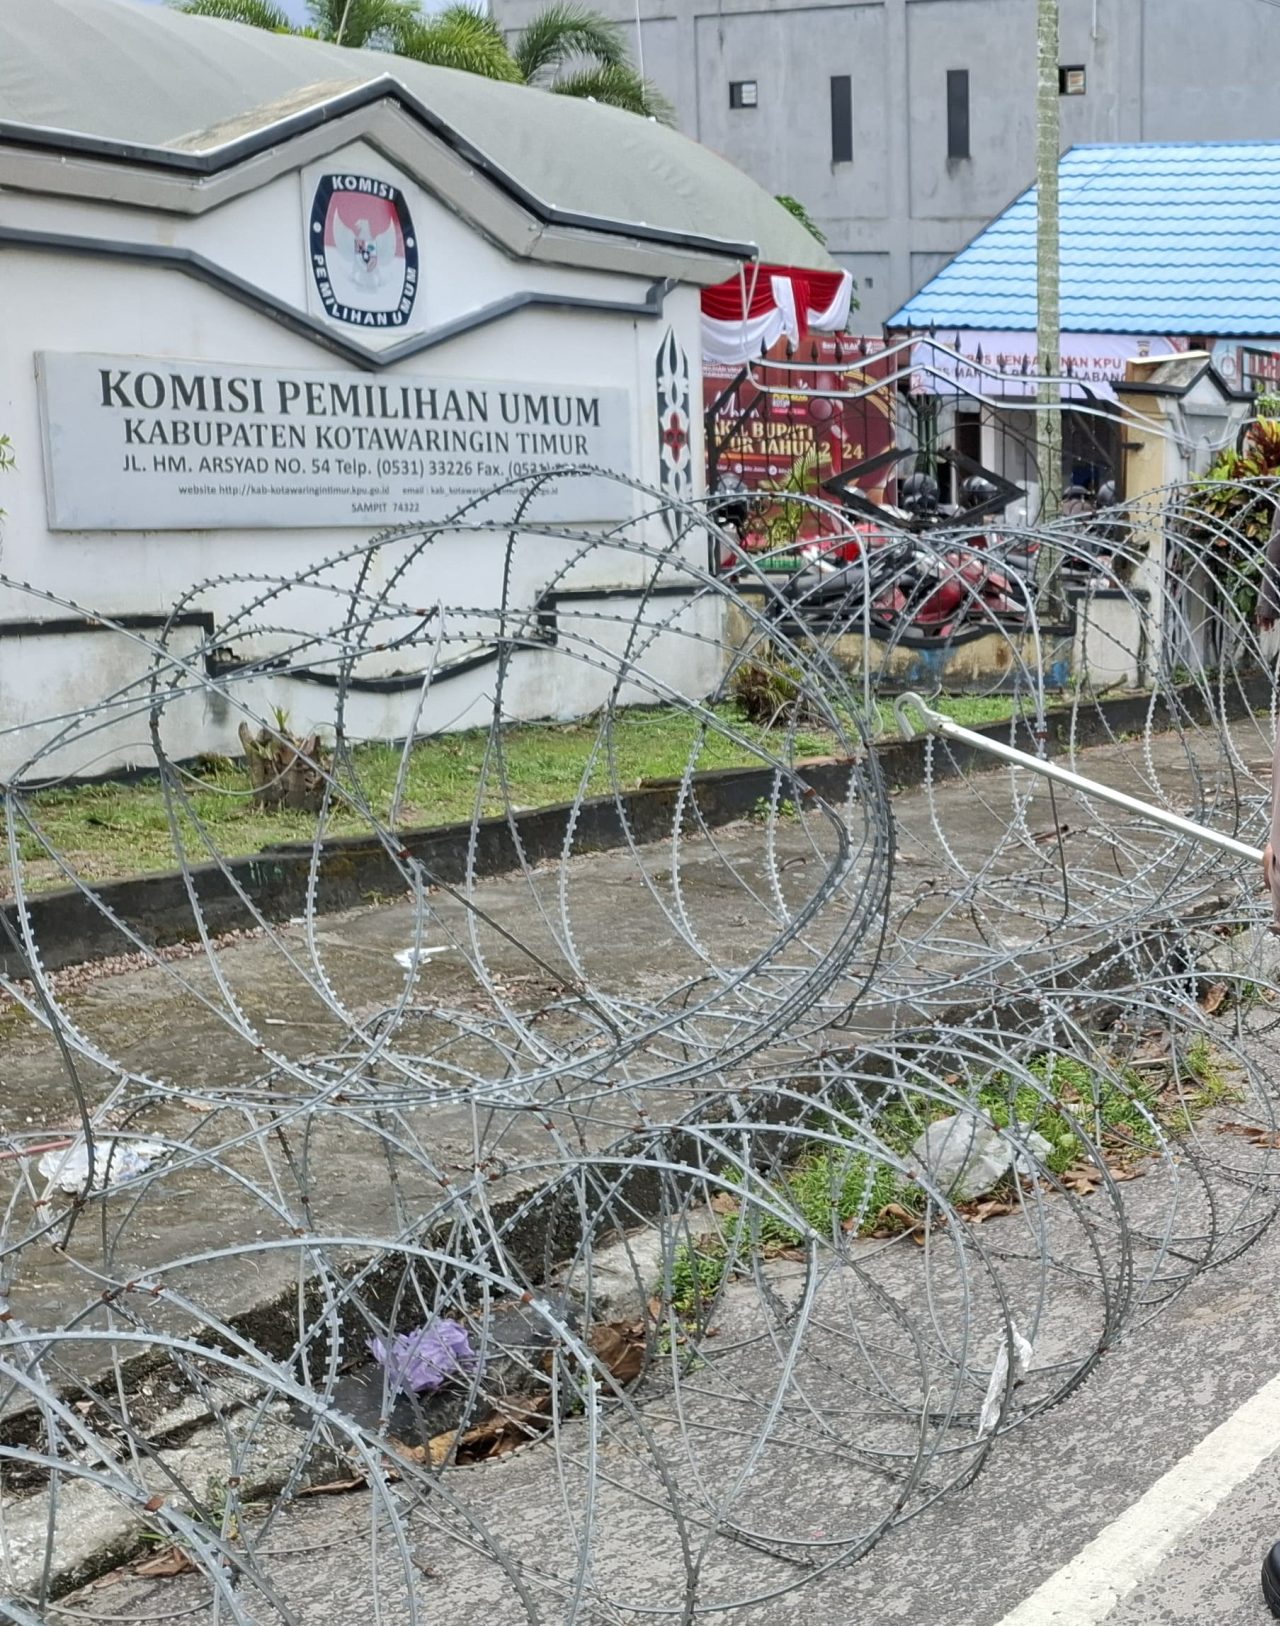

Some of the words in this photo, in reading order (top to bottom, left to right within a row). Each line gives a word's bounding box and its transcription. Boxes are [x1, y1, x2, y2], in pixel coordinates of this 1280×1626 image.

[332, 176, 394, 200] KOMISI
[314, 254, 388, 326] PEMILIHAN
[392, 266, 416, 324] UMUM
[1094, 357, 1120, 370] KPU
[99, 369, 264, 414] KOMISI
[277, 380, 489, 423] PEMILIHAN
[499, 392, 601, 427] UMUM
[124, 418, 306, 449] KABUPATEN
[316, 424, 509, 454] KOTAWARINGIN
[516, 432, 589, 456] TIMUR
[752, 421, 813, 440] BUPATI
[820, 441, 865, 461] 224
[123, 455, 146, 472] JL.
[153, 456, 192, 472] HM.
[199, 456, 269, 473] ARSYAD
[275, 457, 306, 475] NO.
[311, 458, 331, 474] 54
[335, 459, 371, 478] Telp.
[377, 459, 424, 479] (0531)
[428, 461, 472, 476] 33226
[477, 461, 504, 477] Fax.
[178, 484, 216, 495] website
[402, 486, 424, 495] email
[352, 503, 386, 513] SAMPIT
[393, 503, 419, 513] 74322
